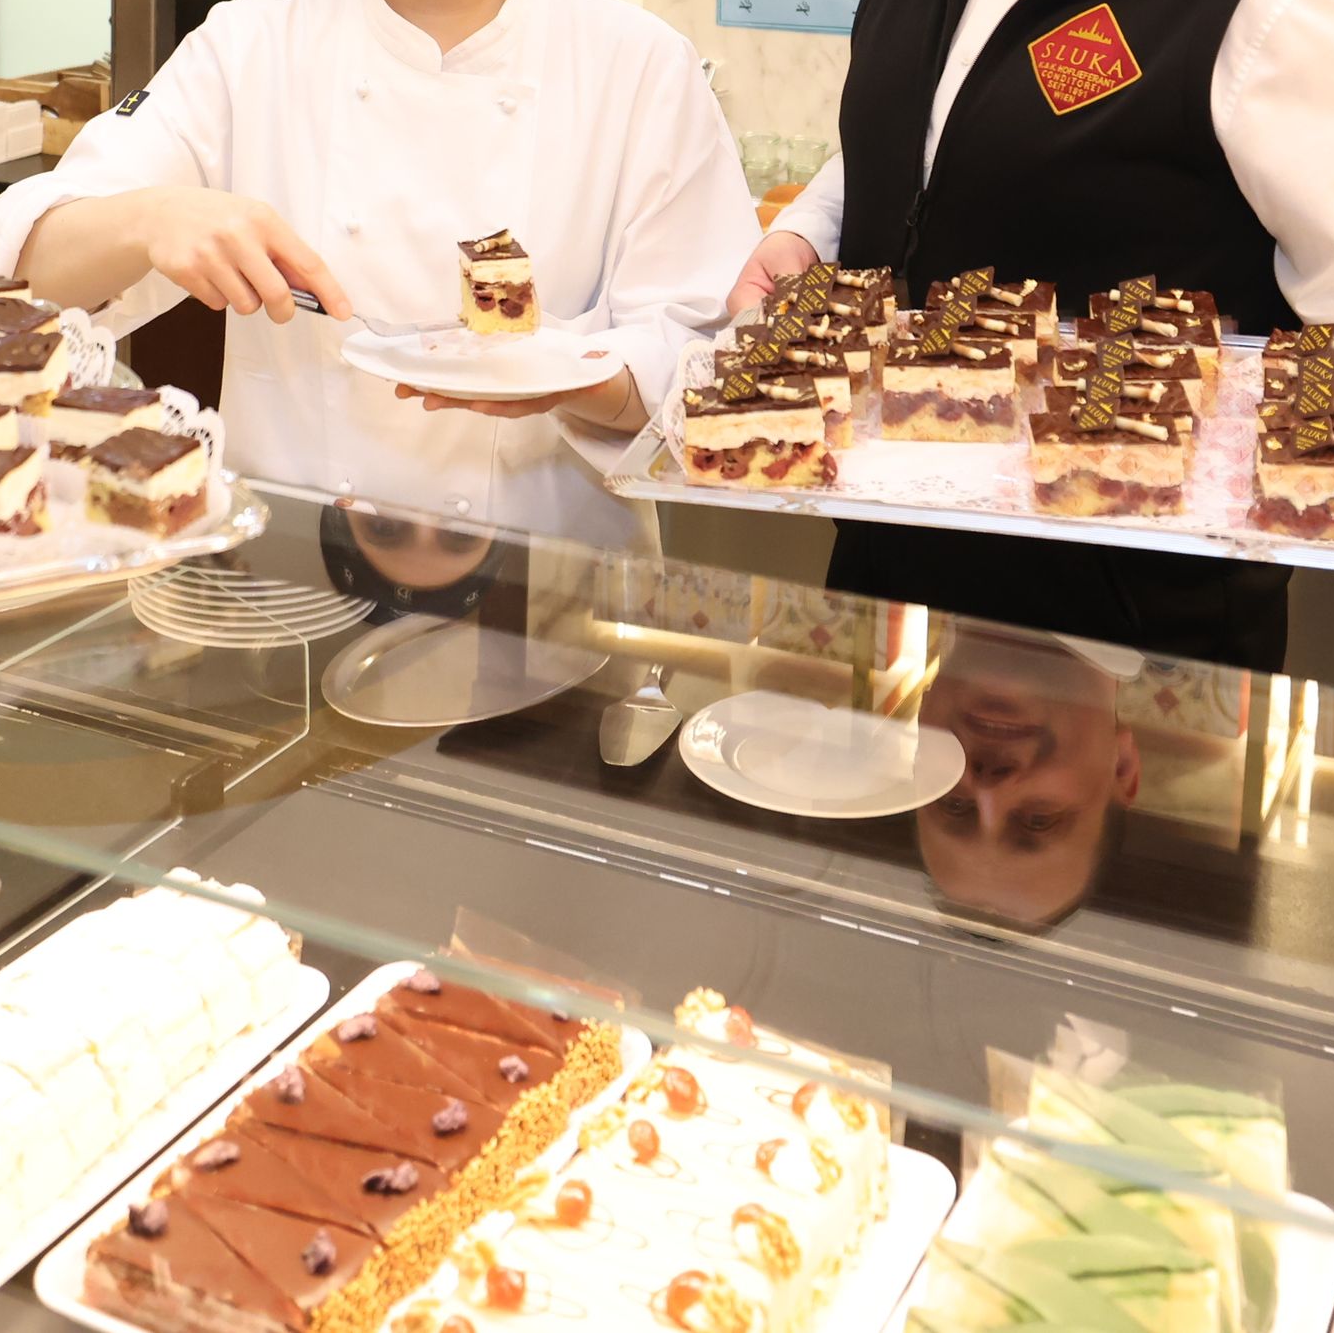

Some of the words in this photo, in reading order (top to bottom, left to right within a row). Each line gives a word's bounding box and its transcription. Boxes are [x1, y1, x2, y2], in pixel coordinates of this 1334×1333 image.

[1041, 42, 1124, 79] SLUKA
[1041, 69, 1101, 93] CONDITOREI
[1058, 64, 1116, 89] HOFLIEFERANT
[1047, 80, 1066, 92] SEIT
[1068, 85, 1089, 99] 1891
[1053, 90, 1076, 104] WIEN
[813, 265, 831, 284] SLUKA
[802, 289, 824, 310] SLUKA
[1125, 282, 1152, 301] SLUKA
[778, 316, 802, 339] SLUKA
[1110, 309, 1138, 326] SLUKA
[1307, 326, 1327, 348] SLUKA
[1102, 344, 1132, 361] SLUKA
[1303, 359, 1333, 380] SLUKA
[728, 374, 751, 395] SLUKA
[1091, 374, 1120, 394] SLUKA
[1302, 384, 1331, 410] SLUKA
[1085, 404, 1110, 426] SLUKA
[1296, 426, 1328, 442] SLUKA
